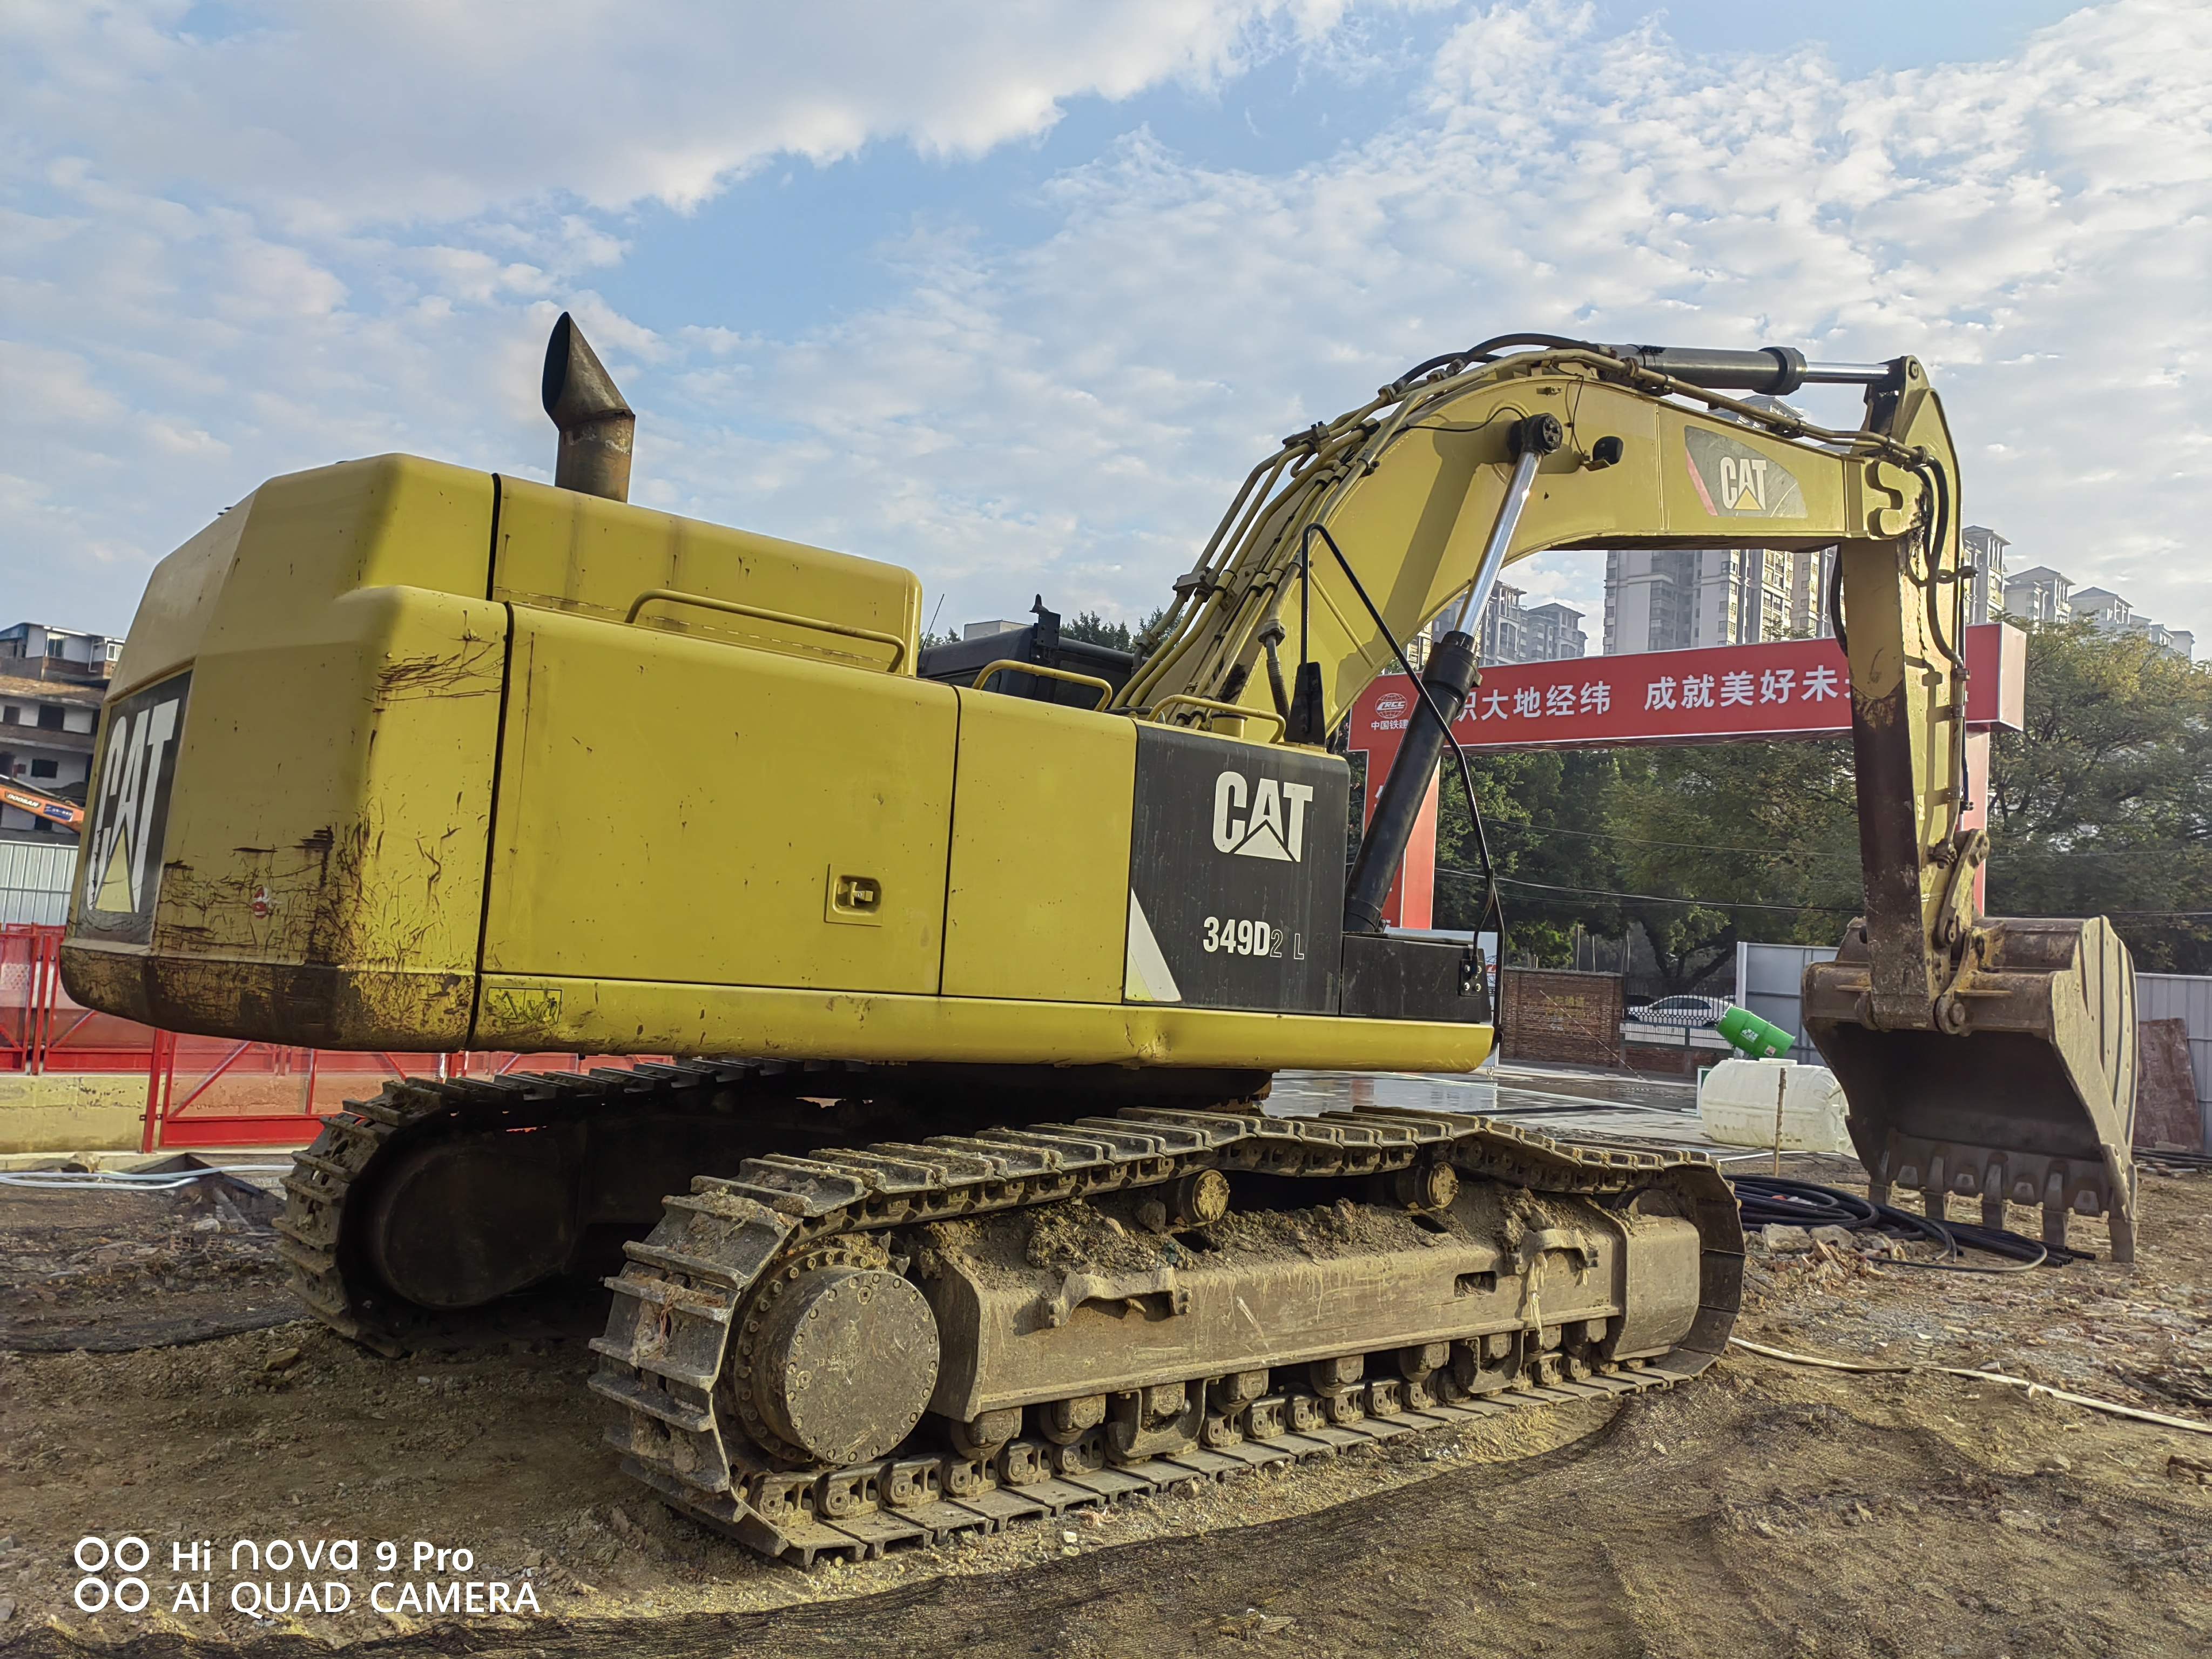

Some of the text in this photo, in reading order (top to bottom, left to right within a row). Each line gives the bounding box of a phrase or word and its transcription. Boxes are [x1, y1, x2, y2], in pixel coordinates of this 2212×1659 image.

[1721, 456, 1767, 510] CAT
[1377, 701, 1406, 711] CRCC
[1644, 665, 1850, 711] 成就美好未
[1371, 719, 1408, 731] 中国铁建
[7, 793, 39, 807] DOOSAN
[87, 699, 179, 913] CAT
[1212, 771, 1313, 863] CAT
[1293, 933, 1305, 960] L
